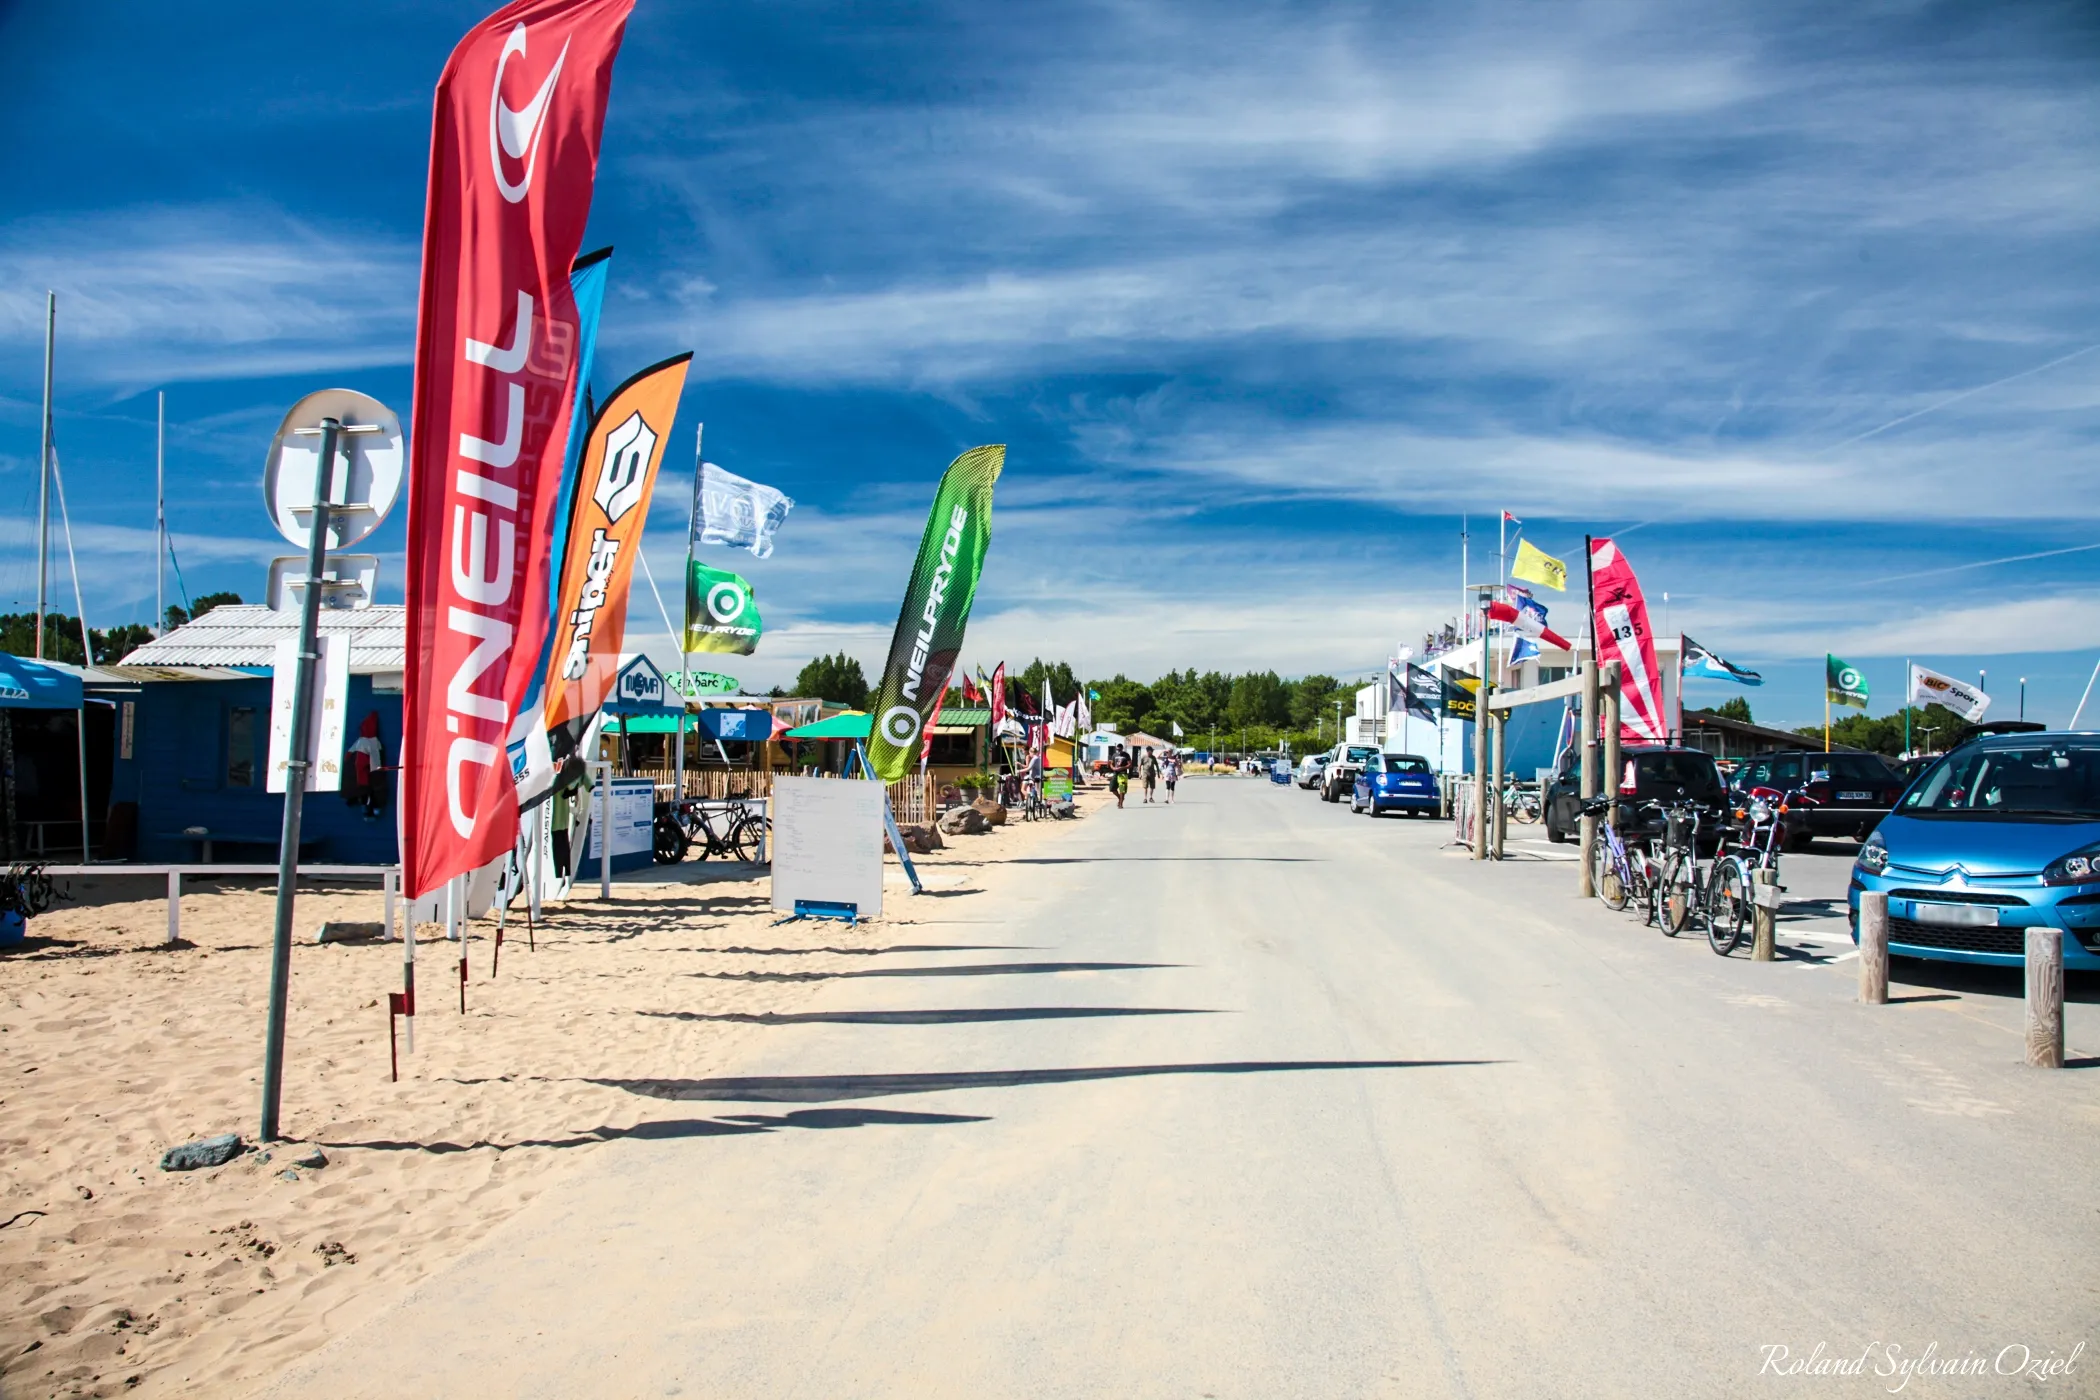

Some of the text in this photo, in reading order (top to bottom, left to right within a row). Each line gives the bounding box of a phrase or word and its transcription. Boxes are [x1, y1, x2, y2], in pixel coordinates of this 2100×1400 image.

[902, 503, 969, 702] NEILPRYDE
[1612, 622, 1644, 641] 135
[1950, 687, 1979, 705] Sport
